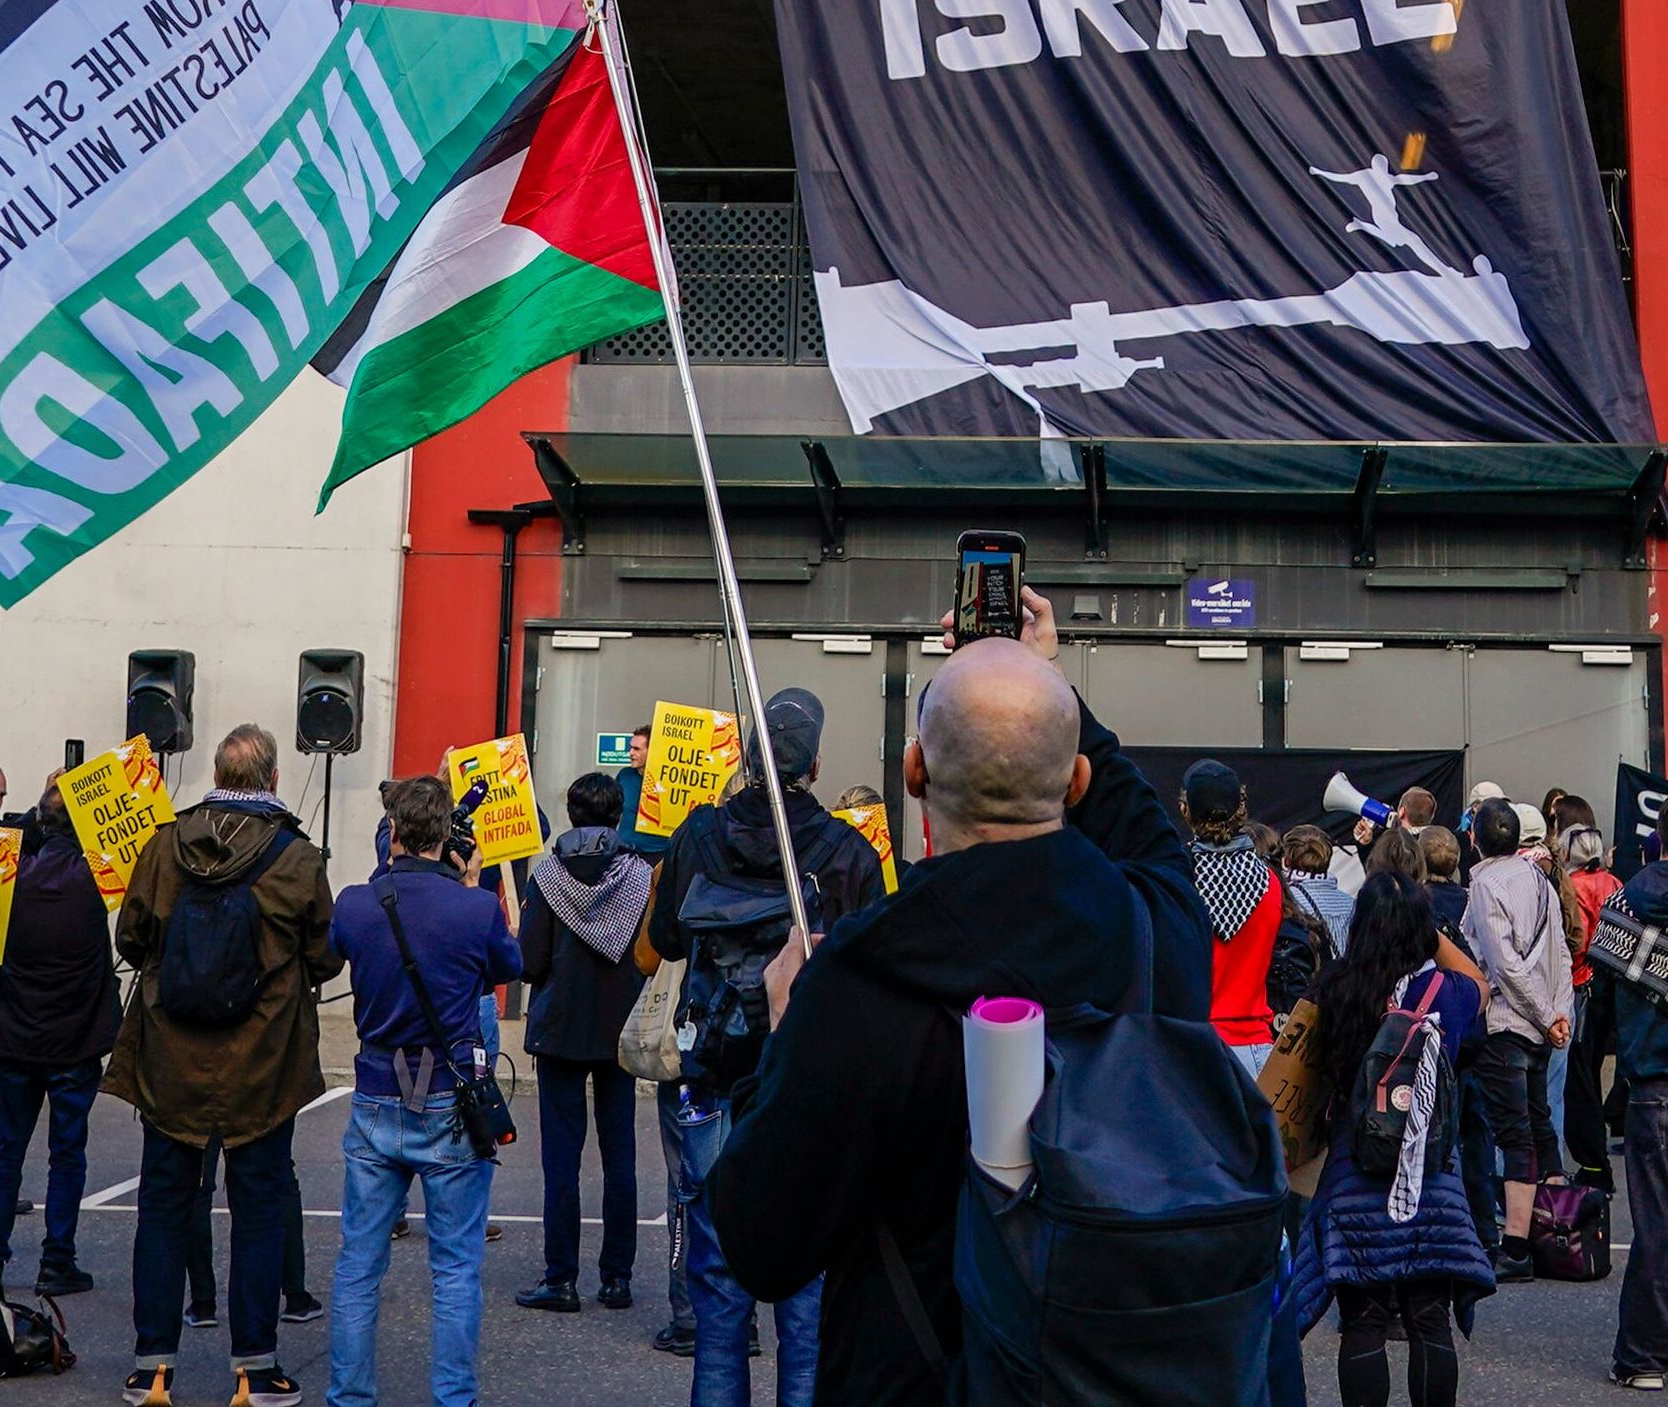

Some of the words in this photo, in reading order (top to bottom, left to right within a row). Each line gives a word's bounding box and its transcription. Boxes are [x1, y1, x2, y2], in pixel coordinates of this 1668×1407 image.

[662, 726, 694, 741] ISRAEL
[664, 713, 705, 730] BOIKOTT
[668, 745, 711, 767] OLJE-
[71, 764, 113, 794] BOIKOTT
[660, 765, 720, 790] FONDET
[76, 783, 111, 807] ISRAEL
[670, 788, 691, 806] UT
[93, 793, 138, 826] OLJE-
[483, 804, 526, 826] GLOBAL
[97, 805, 156, 851] FONDET
[483, 820, 533, 844] INTIFADA
[118, 840, 140, 865] UT
